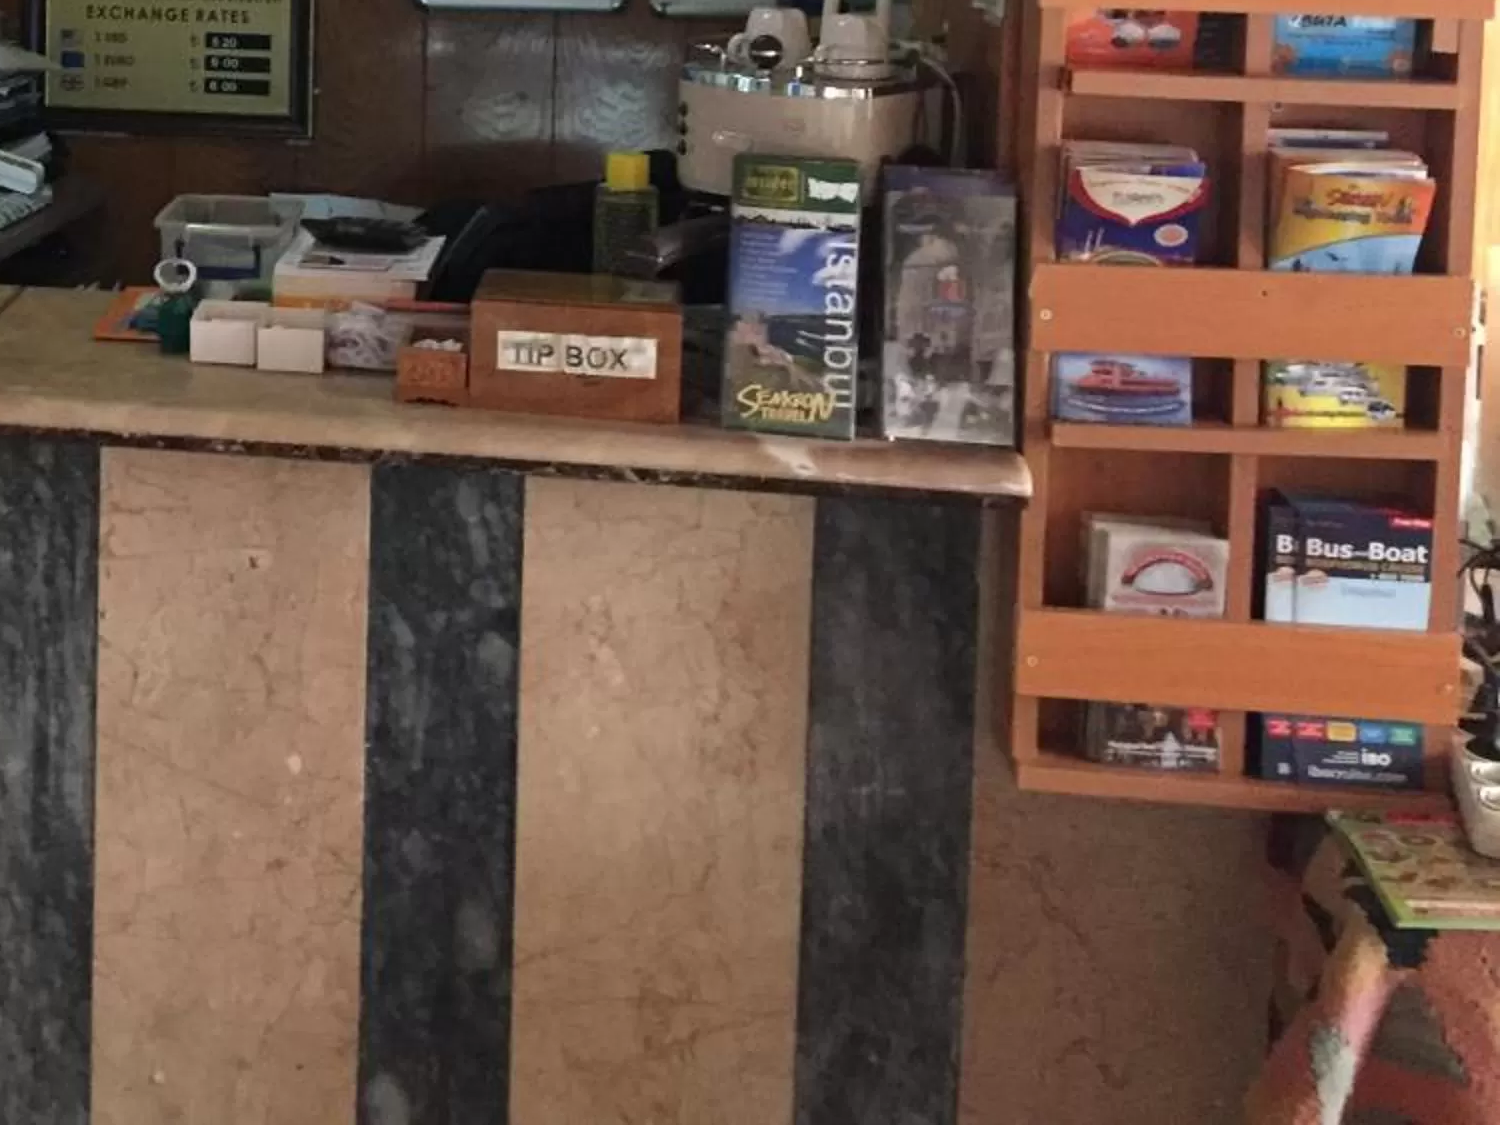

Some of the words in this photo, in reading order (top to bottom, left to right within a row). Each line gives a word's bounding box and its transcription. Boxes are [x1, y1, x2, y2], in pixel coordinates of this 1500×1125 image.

[85, 4, 190, 23] EXCHANGE
[196, 9, 251, 24] RATES
[823, 241, 858, 409] Istanbul
[513, 342, 554, 366] TIP
[565, 345, 628, 372] BOX
